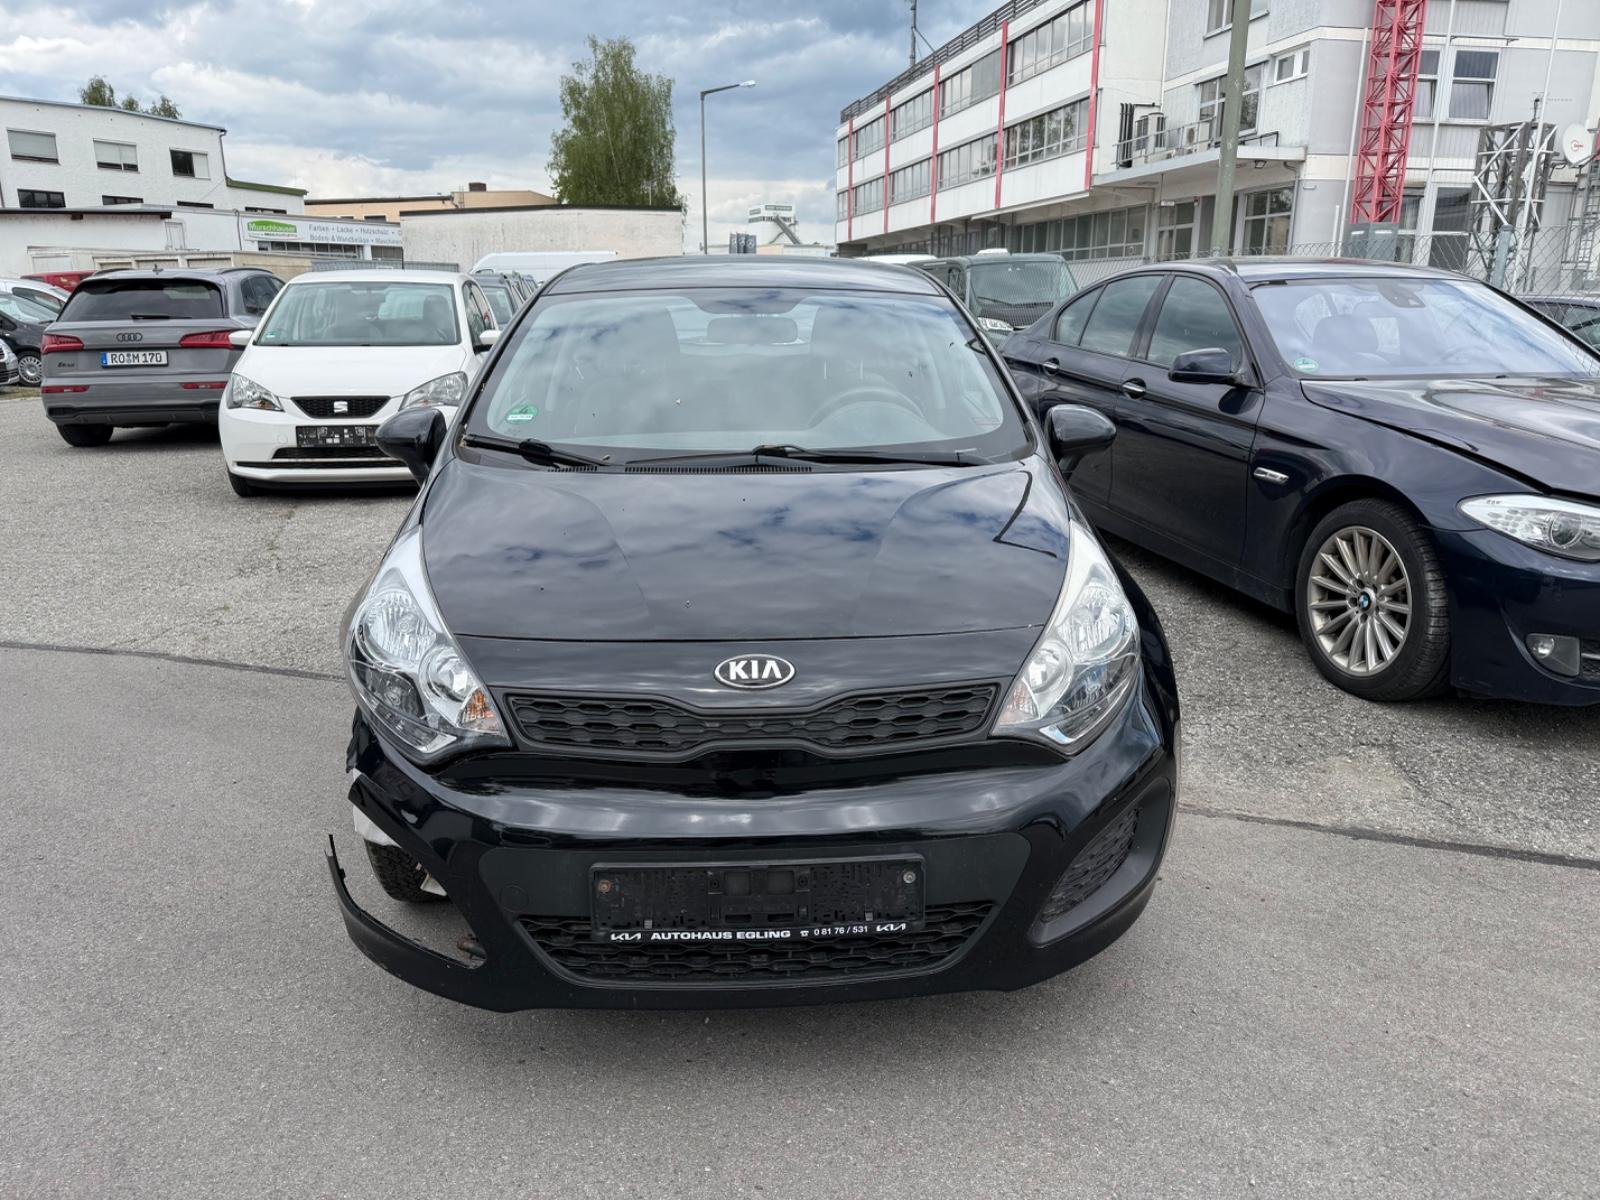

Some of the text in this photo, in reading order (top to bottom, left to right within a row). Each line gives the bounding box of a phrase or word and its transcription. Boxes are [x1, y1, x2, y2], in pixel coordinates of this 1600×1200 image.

[309, 224, 330, 232] Farben
[110, 352, 162, 364] RO M 170
[729, 660, 782, 680] KIA
[651, 932, 732, 940] AUTOHAUS
[736, 930, 791, 939] EGLING
[852, 925, 868, 933] 531
